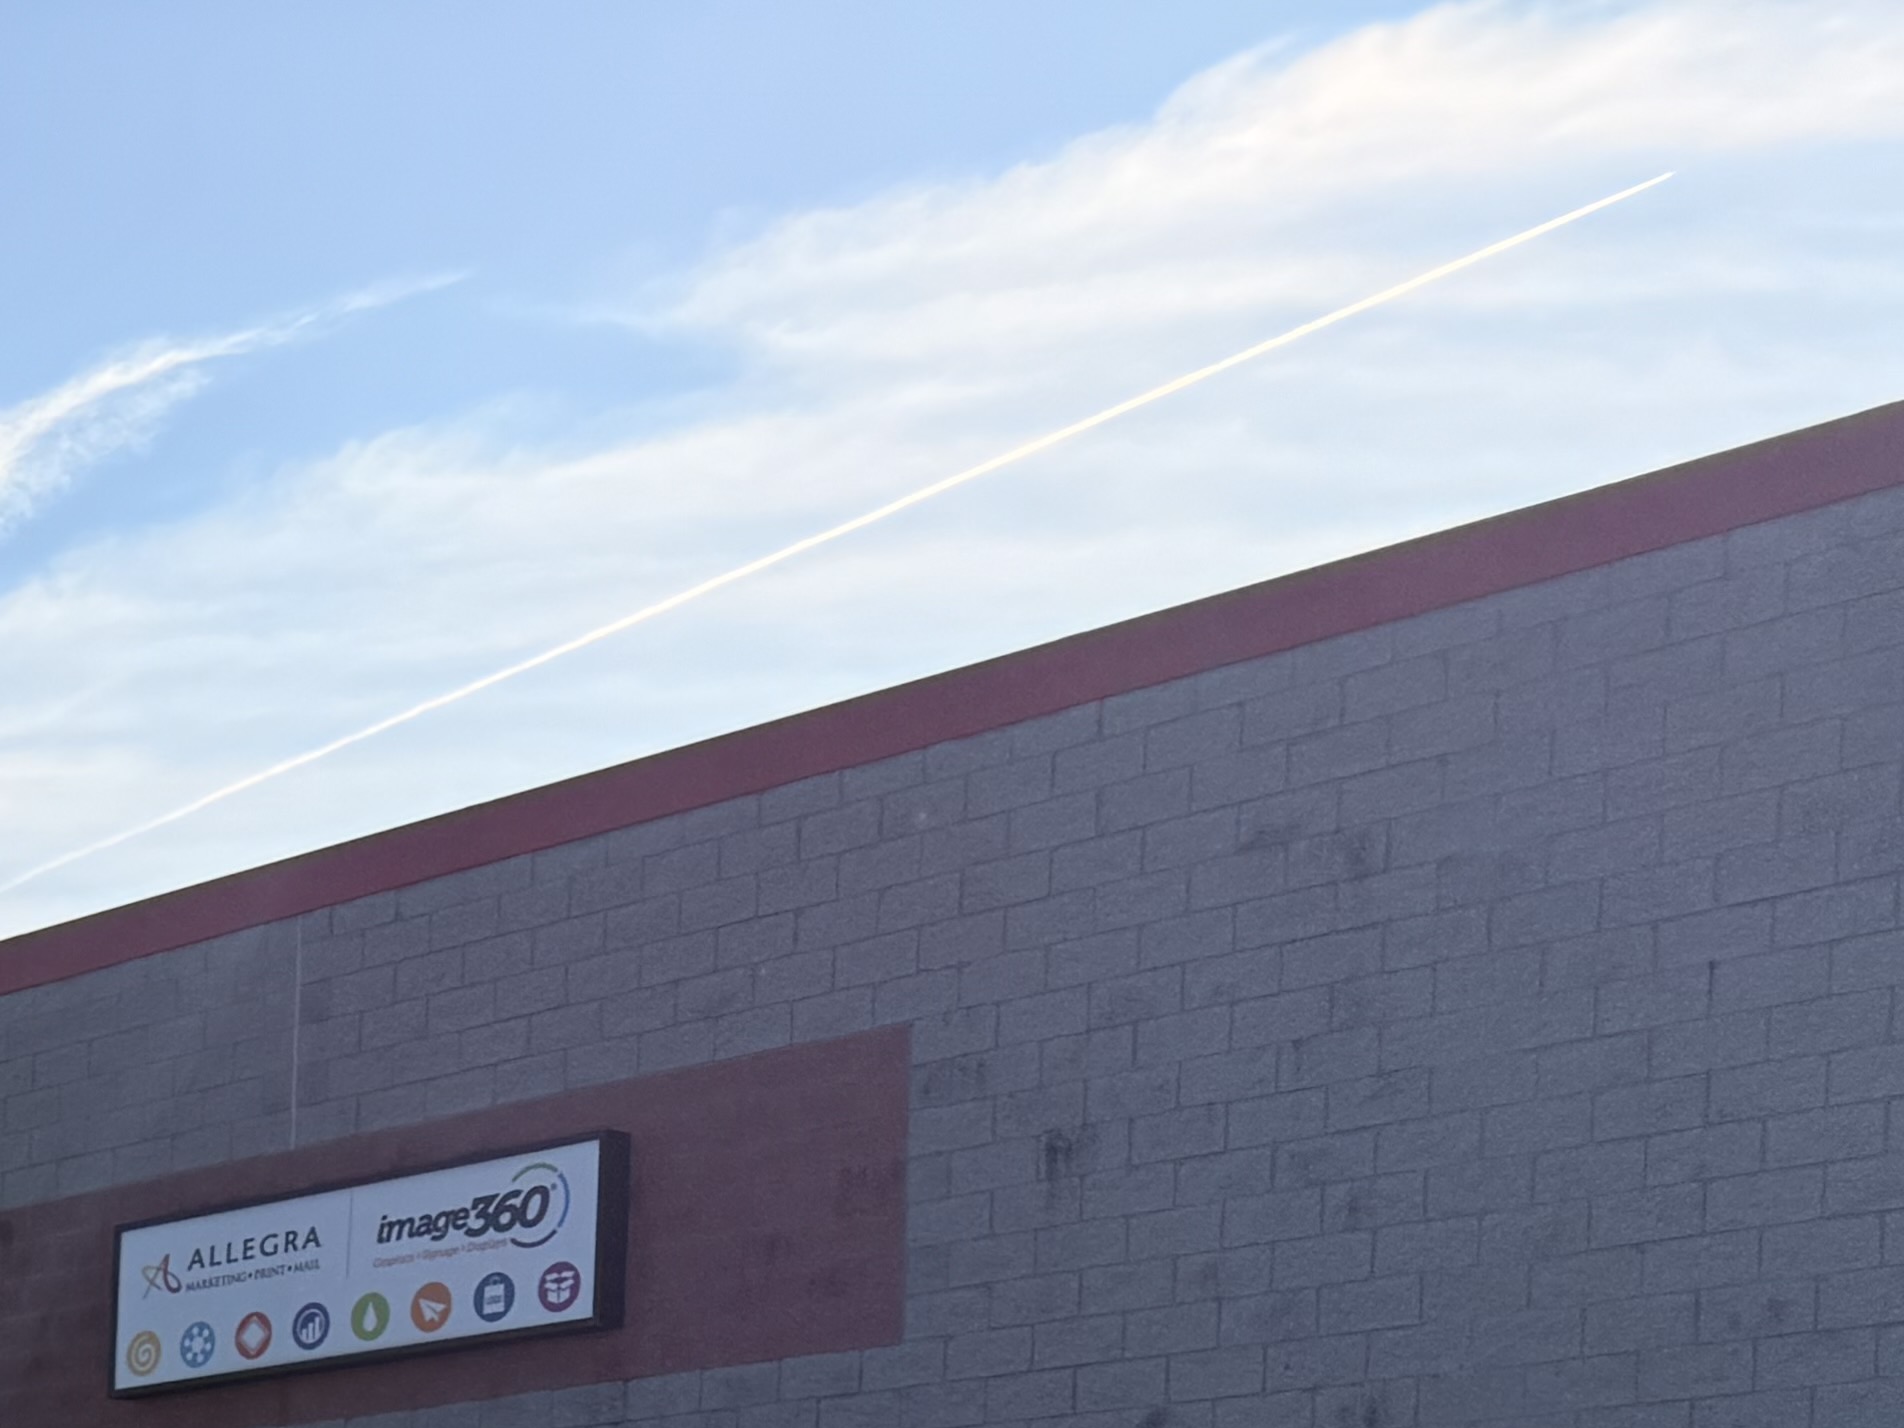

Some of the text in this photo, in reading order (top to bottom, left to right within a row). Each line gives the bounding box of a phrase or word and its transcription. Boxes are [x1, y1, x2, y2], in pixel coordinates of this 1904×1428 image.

[376, 1185, 550, 1244] image360
[187, 1226, 322, 1271] ALLEGRA
[186, 1258, 320, 1291] MARKETING PRINT MAIL
